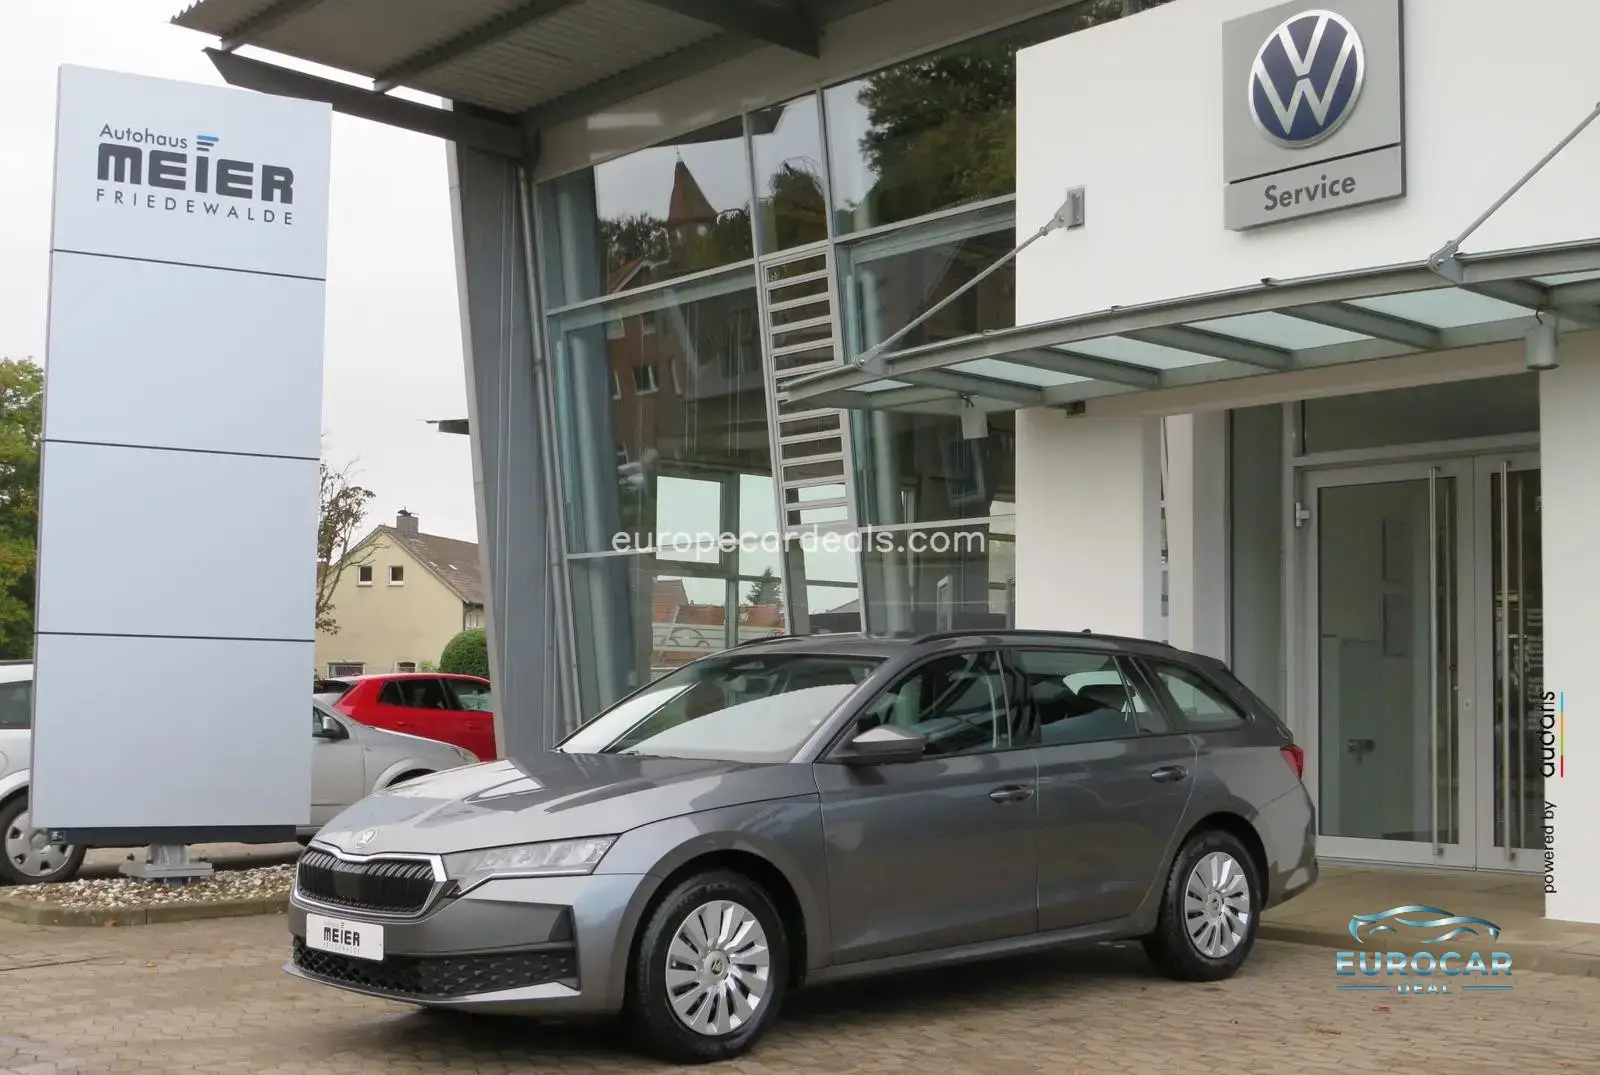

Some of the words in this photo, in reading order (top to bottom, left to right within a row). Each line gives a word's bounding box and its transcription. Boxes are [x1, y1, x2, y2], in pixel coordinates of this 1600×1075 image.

[99, 123, 188, 149] Autohaus
[97, 142, 294, 204] MEIER
[96, 188, 293, 225] FRIEDEWALDE
[1264, 174, 1356, 211] Service
[323, 926, 361, 947] MEIER
